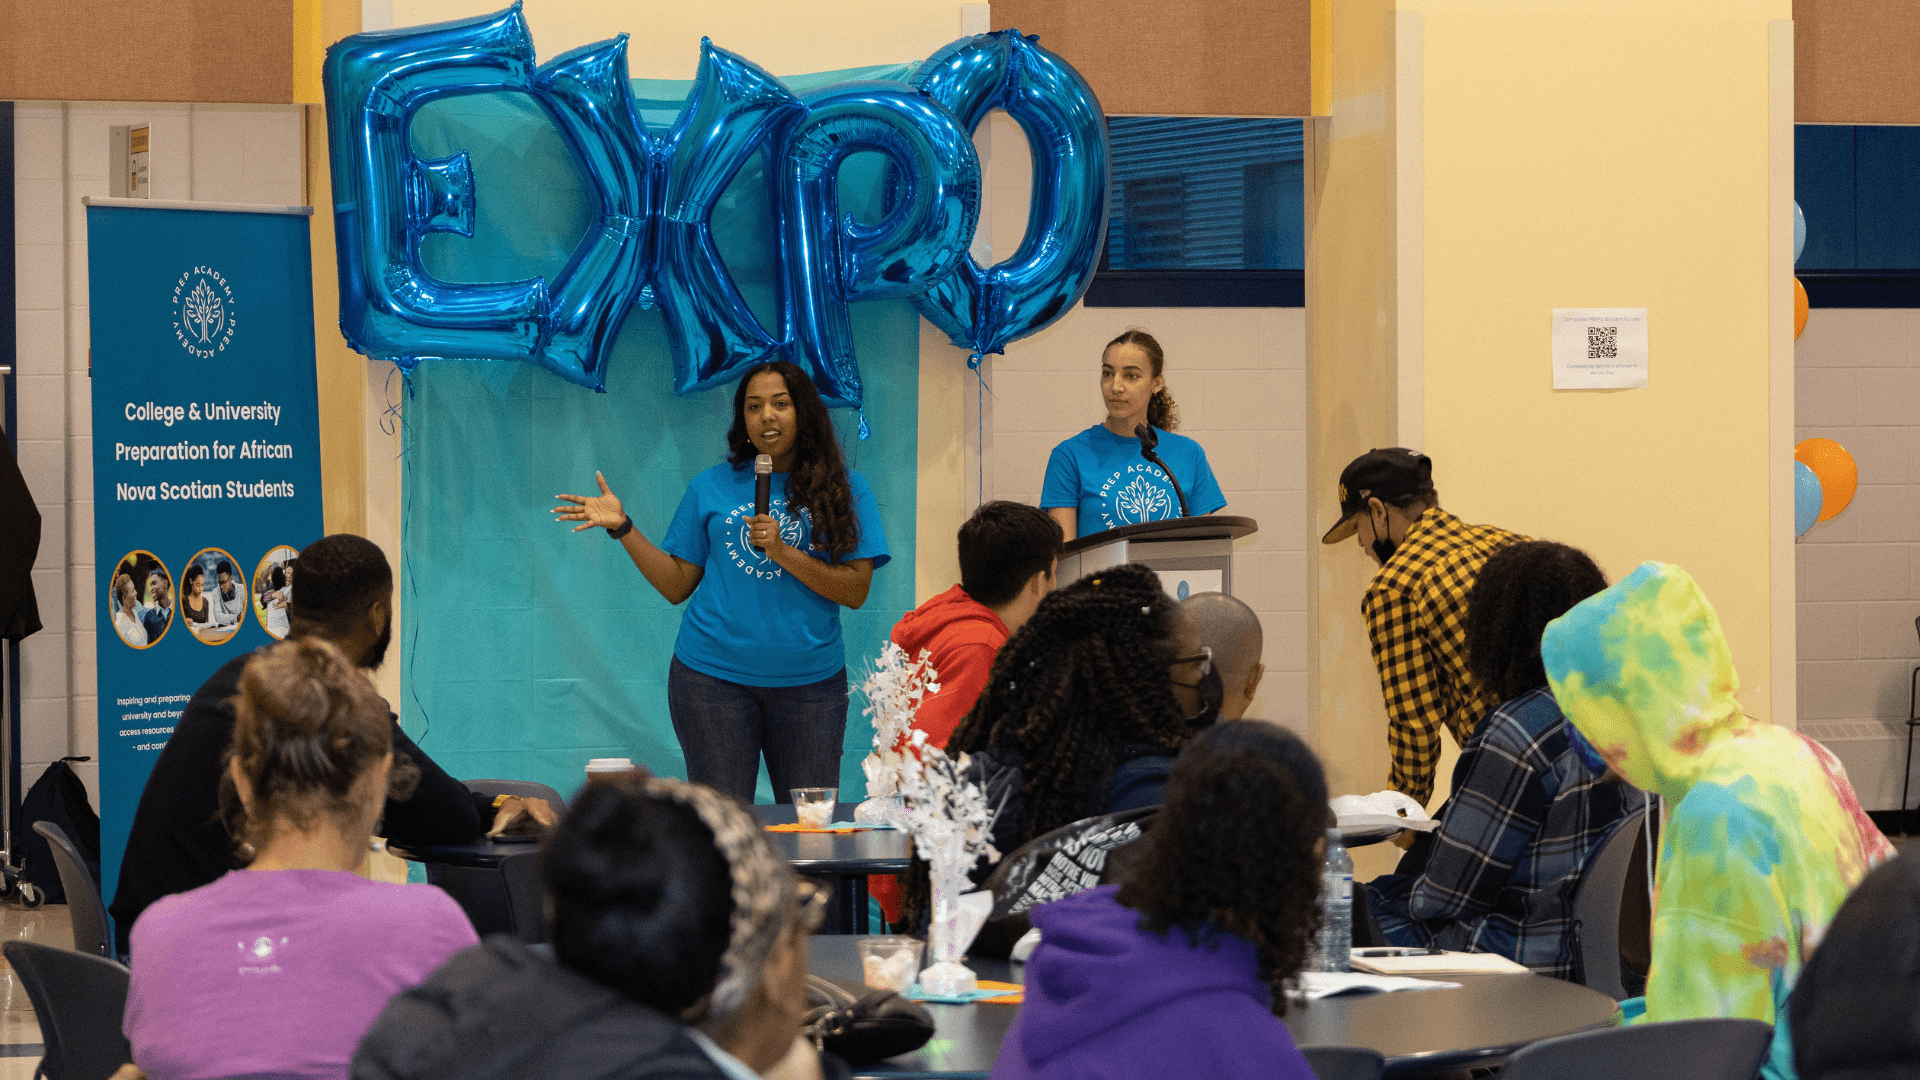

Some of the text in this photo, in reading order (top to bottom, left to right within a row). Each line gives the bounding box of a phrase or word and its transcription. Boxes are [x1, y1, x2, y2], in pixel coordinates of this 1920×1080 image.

[323, 1, 1110, 408] EXPO
[172, 265, 235, 304] PREP ACADEMY
[173, 318, 236, 359] PREP ACADEMY
[125, 400, 281, 427] College & University
[115, 439, 293, 467] Preparation for African
[116, 479, 295, 501] Nova Scotian Students
[1100, 471, 1121, 497] PREP
[725, 502, 755, 525] PREP
[725, 541, 782, 580] ACADEMY
[116, 693, 191, 708] Inspiring and preparing
[122, 710, 152, 721] university
[153, 709, 167, 719] and
[119, 726, 175, 737] access resources
[137, 742, 150, 751] and
[151, 740, 168, 750] cont
[1051, 851, 1083, 882] NOTRE
